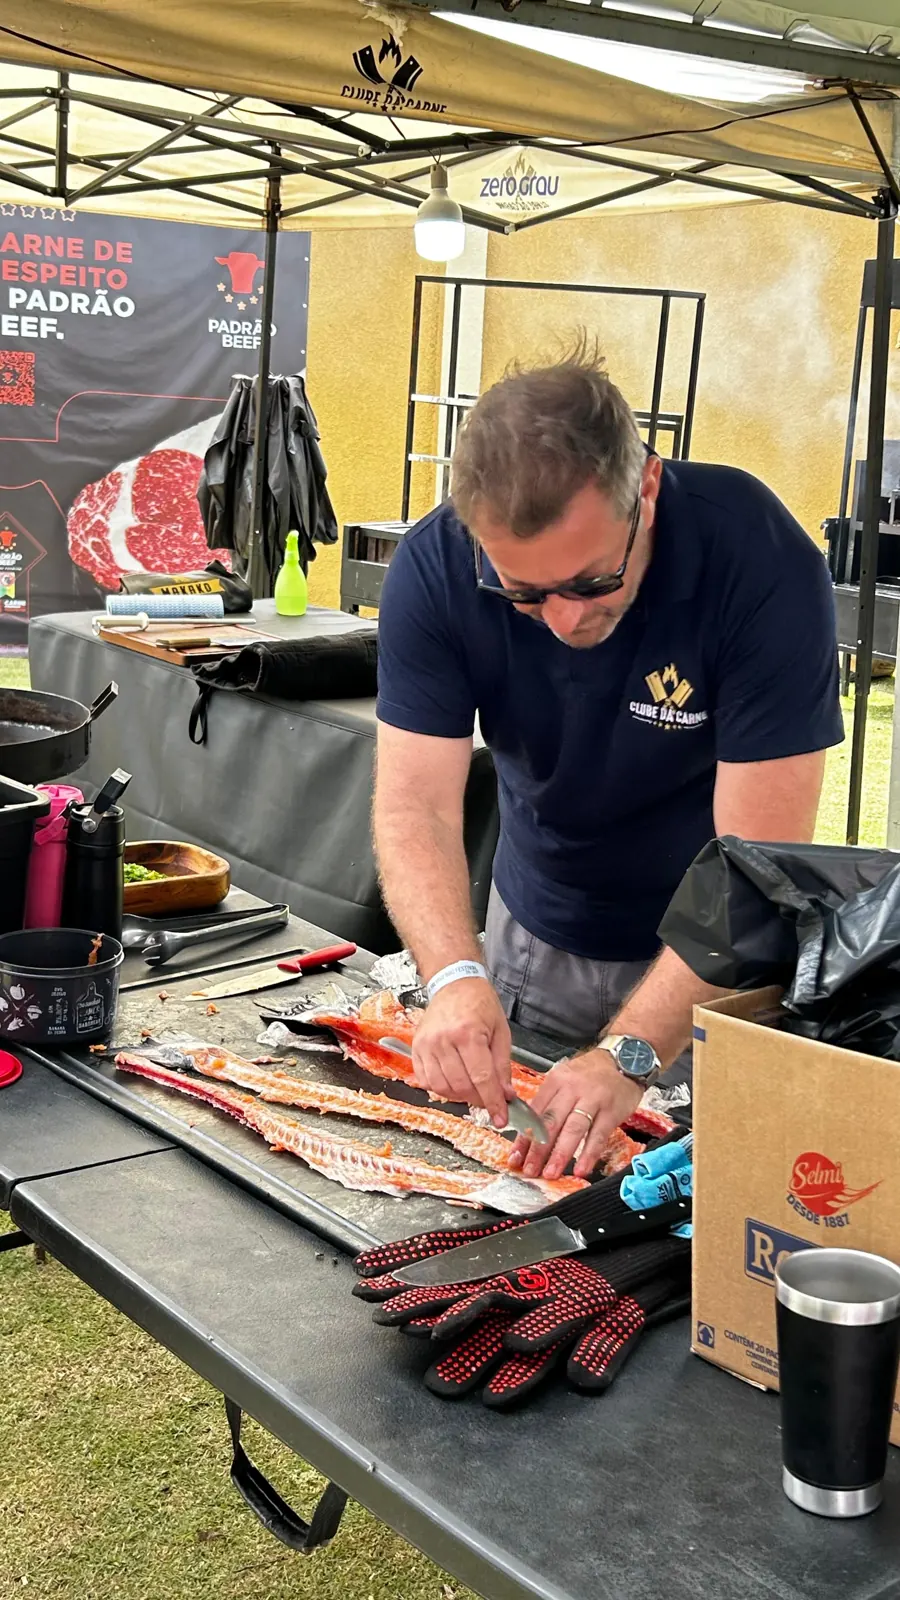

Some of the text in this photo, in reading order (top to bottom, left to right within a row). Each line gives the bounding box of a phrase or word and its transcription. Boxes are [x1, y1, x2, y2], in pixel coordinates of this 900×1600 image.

[0, 232, 133, 263] ARNE DE
[1, 259, 128, 290] ESPEITO
[9, 287, 135, 318] PADRÃO
[1, 314, 64, 340] EEF.
[222, 334, 262, 349] BEEF
[629, 701, 659, 719] CLUBE
[675, 710, 708, 725] CARNE
[789, 1160, 844, 1190] Selmi
[785, 1193, 851, 1228] DESDE 1887
